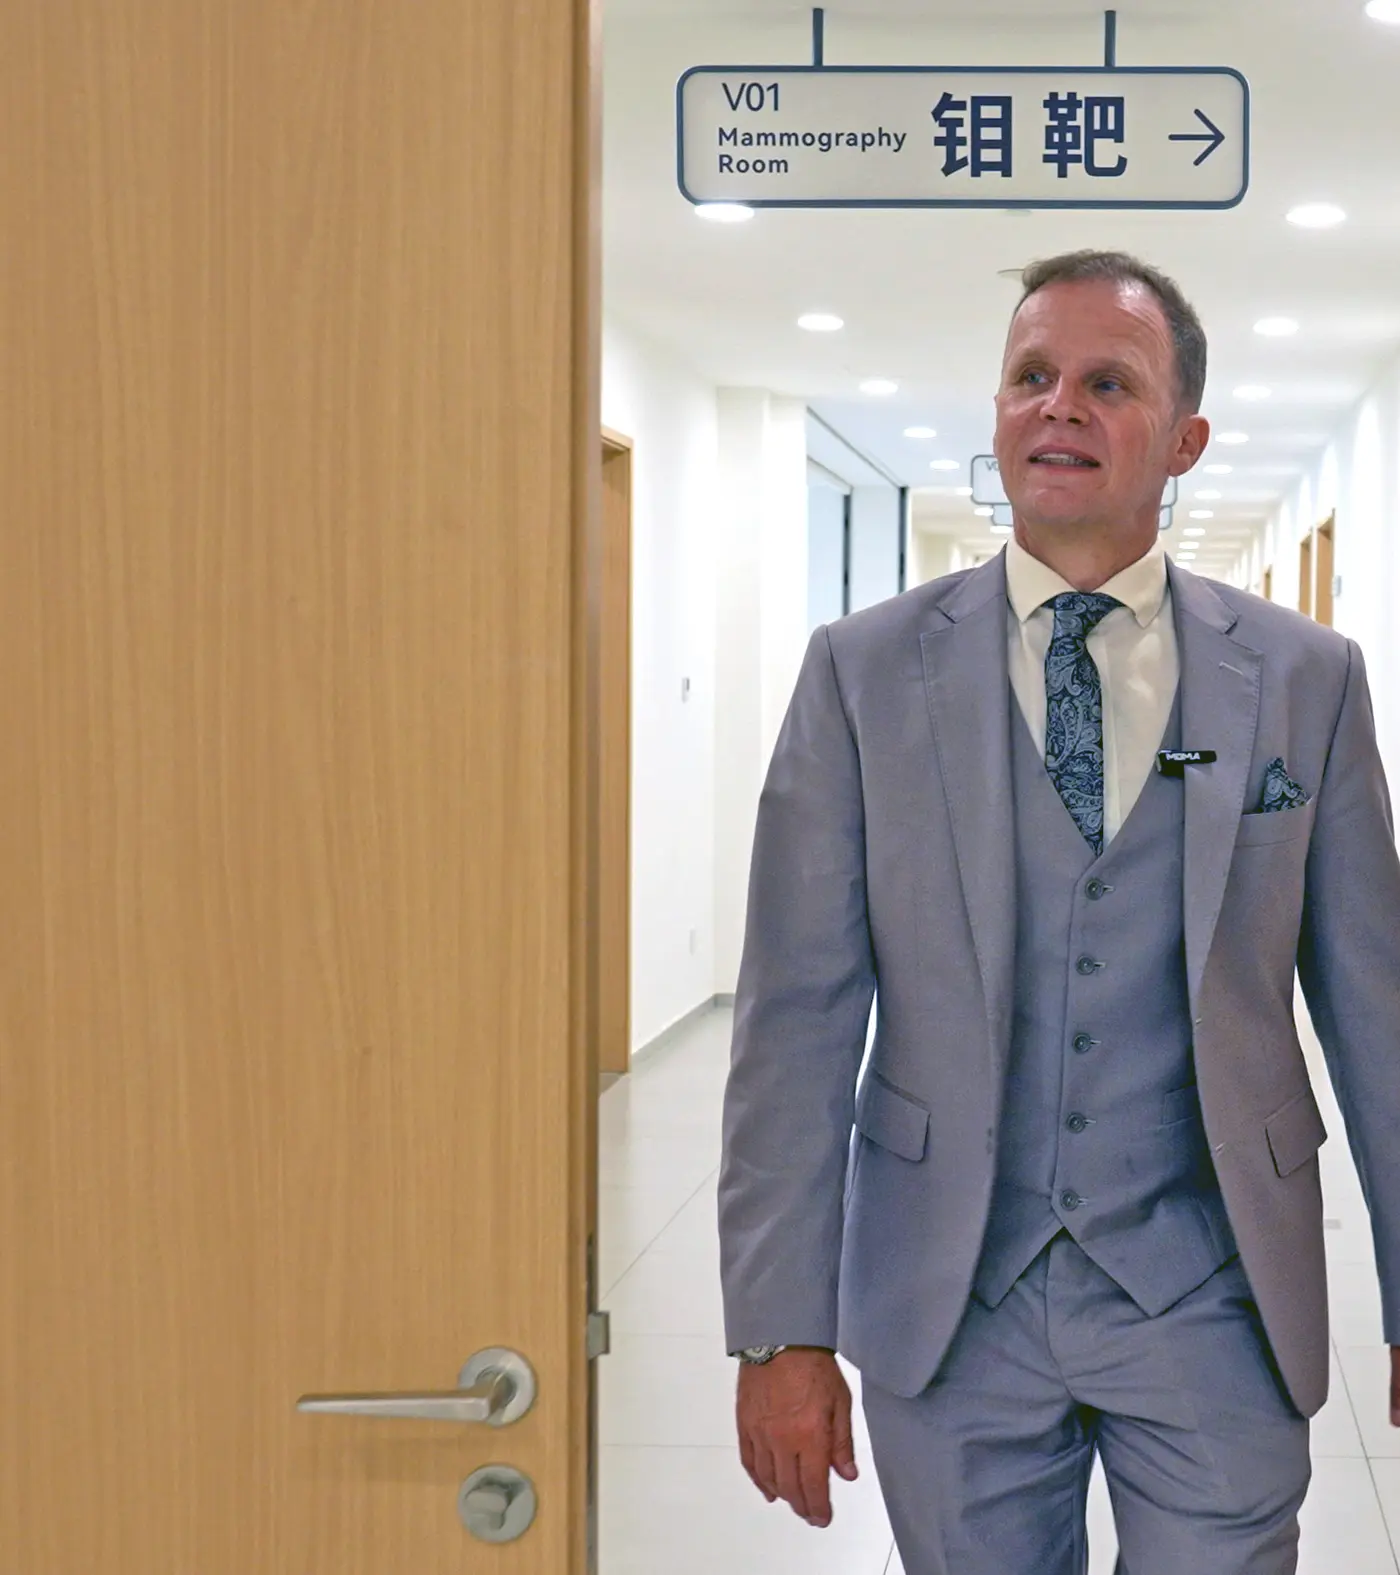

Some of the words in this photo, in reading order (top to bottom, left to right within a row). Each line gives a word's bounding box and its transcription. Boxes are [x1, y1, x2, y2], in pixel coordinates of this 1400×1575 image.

[721, 82, 780, 112] V01
[717, 127, 907, 153] Mammography
[930, 91, 1128, 179] 钼靶
[718, 155, 790, 174] Room
